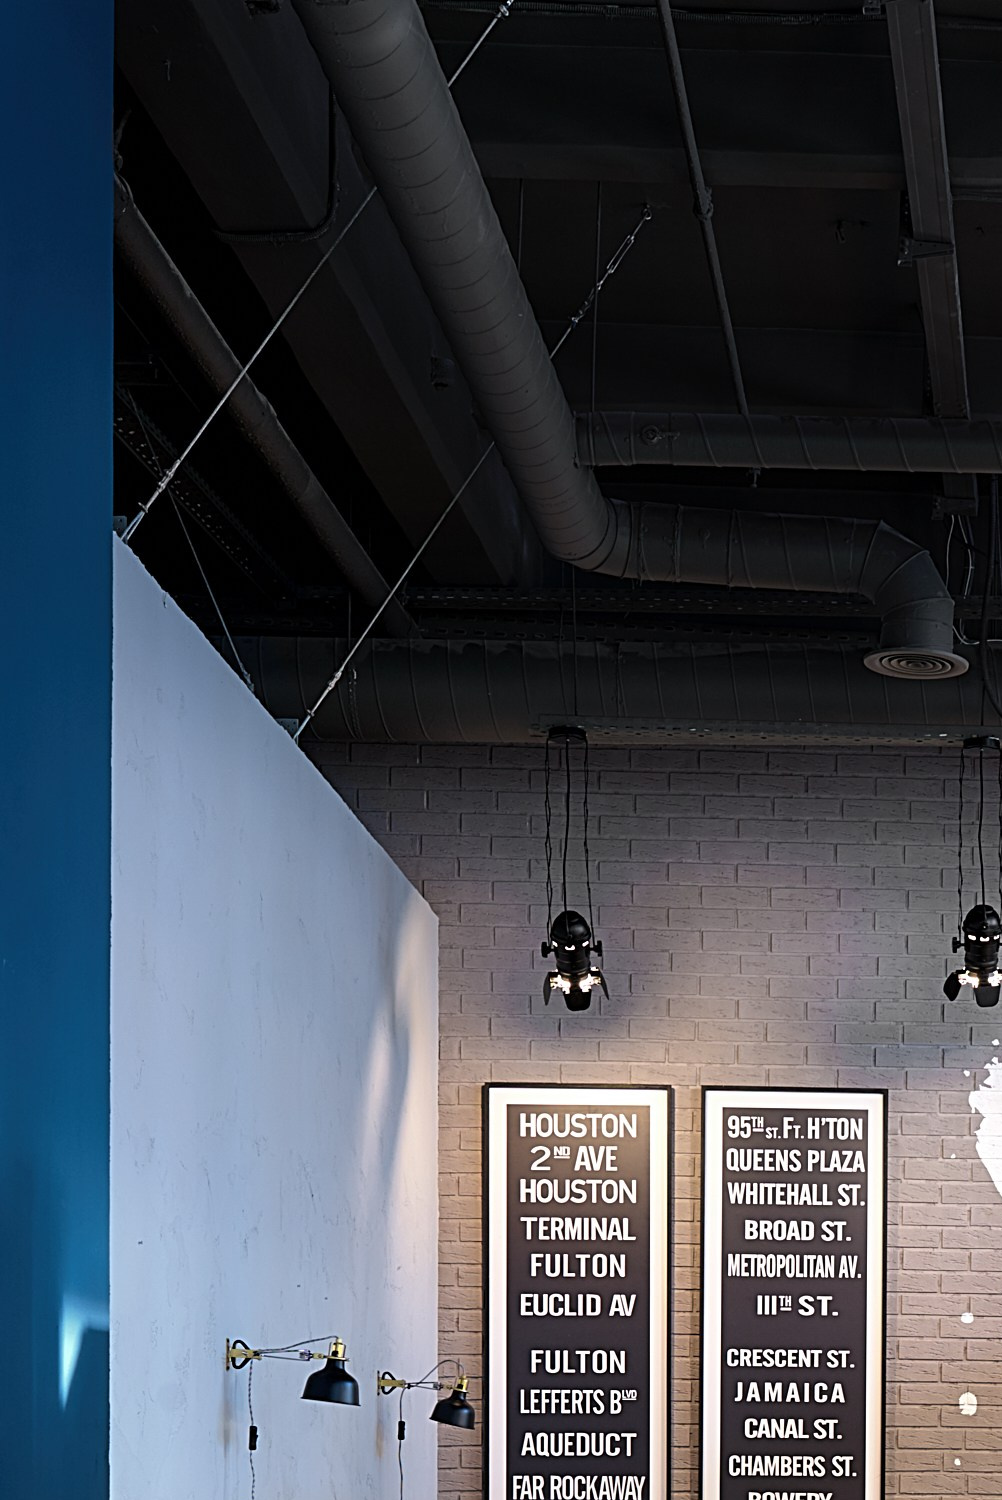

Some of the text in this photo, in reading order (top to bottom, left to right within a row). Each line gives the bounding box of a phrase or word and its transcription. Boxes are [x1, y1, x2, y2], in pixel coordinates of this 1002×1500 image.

[519, 1112, 638, 1139] HOUSTON
[807, 1116, 864, 1141] H'TON
[530, 1145, 618, 1172] 2ND AVE
[725, 1147, 866, 1173] QUEENS PLAZA
[519, 1178, 637, 1204] HOUSTON
[726, 1181, 866, 1207] WHITEHALL ST.
[519, 1216, 637, 1241] TERMINAL
[744, 1219, 852, 1242] BROAD ST.
[530, 1253, 626, 1278] FULTON
[727, 1253, 862, 1279] METROPOLITAN AV.
[520, 1293, 637, 1317] EUCLID AV
[797, 1295, 839, 1317] ST.
[530, 1349, 626, 1374] FULTON
[726, 1348, 855, 1369] CRESCENT ST.
[519, 1388, 605, 1415] LEFFERTS
[734, 1381, 846, 1404] JAMAICA
[744, 1417, 843, 1440] CANAL ST.
[520, 1432, 638, 1457] AQUEDUCT
[728, 1454, 857, 1478] CHAMBERS ST.
[512, 1475, 646, 1500] FAR ROCKAWAY
